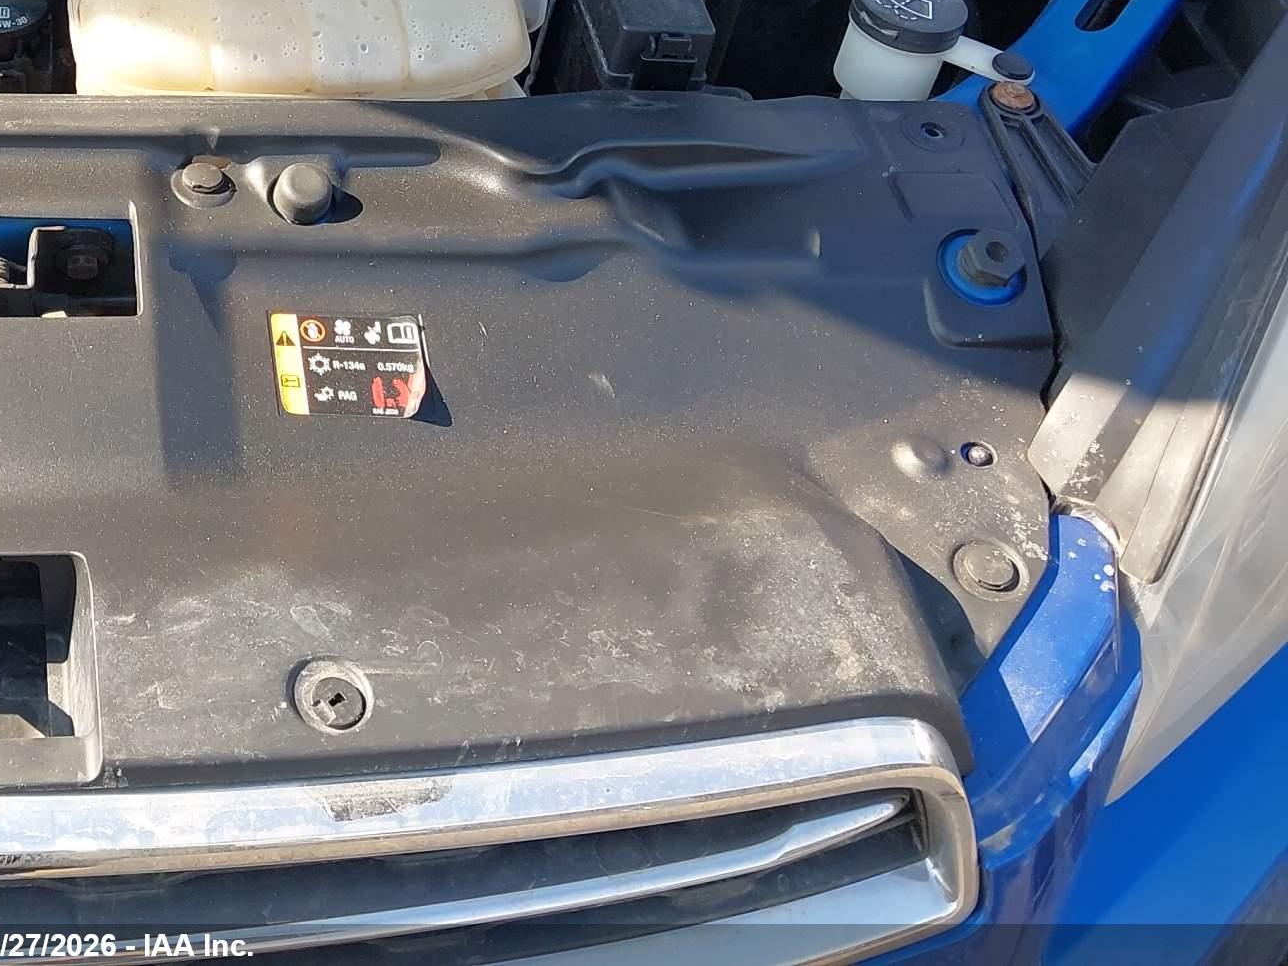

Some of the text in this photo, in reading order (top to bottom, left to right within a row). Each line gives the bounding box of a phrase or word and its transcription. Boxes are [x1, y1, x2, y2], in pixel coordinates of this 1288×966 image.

[334, 335, 355, 344] AUTO
[332, 361, 415, 373] R-134a 0.570kg
[338, 390, 358, 401] PAG
